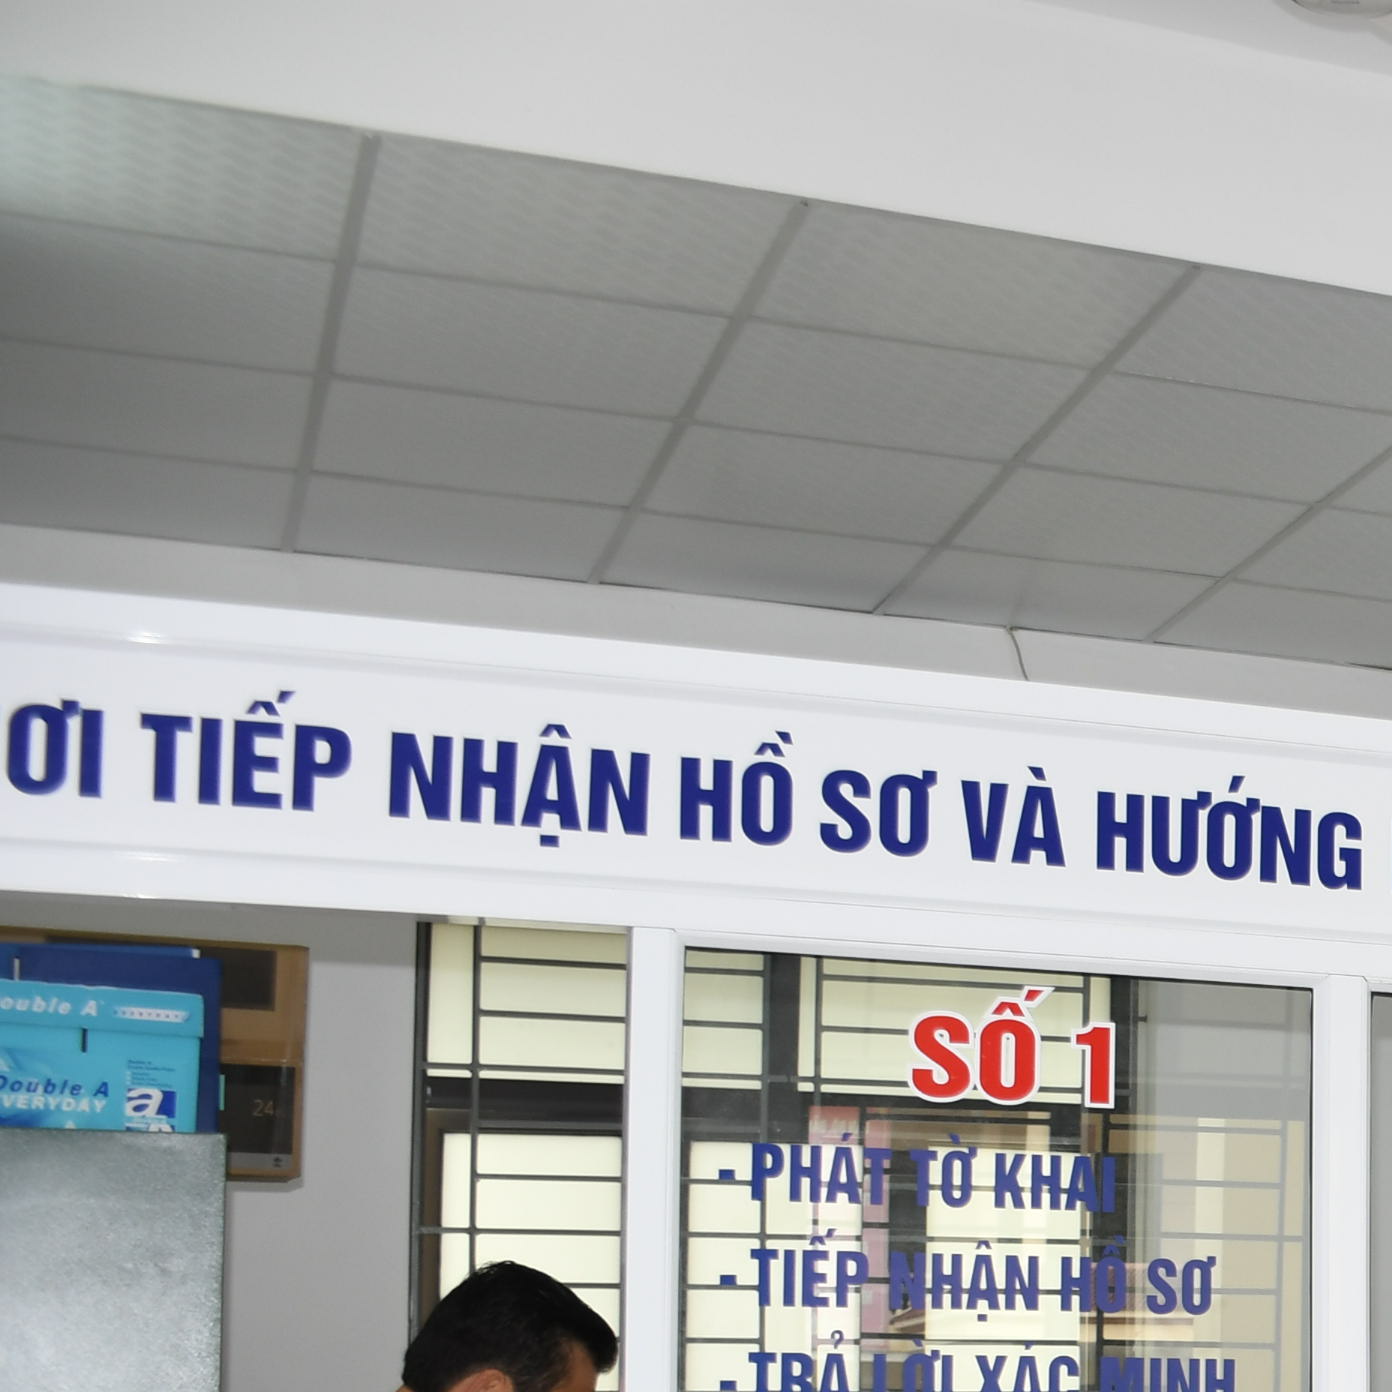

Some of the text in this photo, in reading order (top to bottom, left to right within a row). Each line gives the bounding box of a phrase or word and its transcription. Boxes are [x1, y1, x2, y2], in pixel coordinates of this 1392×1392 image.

[142, 691, 352, 811] TIẾP
[390, 724, 650, 847] NHẬN
[680, 731, 792, 845] HỒ
[819, 770, 936, 857] SƠ
[962, 767, 1064, 865] VÀ
[1096, 775, 1361, 889] HƯỚNG
[80, 1000, 98, 1017] A
[908, 985, 1118, 1110] SỐ 1
[93, 1080, 110, 1098] A
[749, 1130, 1118, 1216] PHÁT TỜ KHAI
[749, 1227, 1218, 1323] TIẾP NHẬN HỒ SƠ
